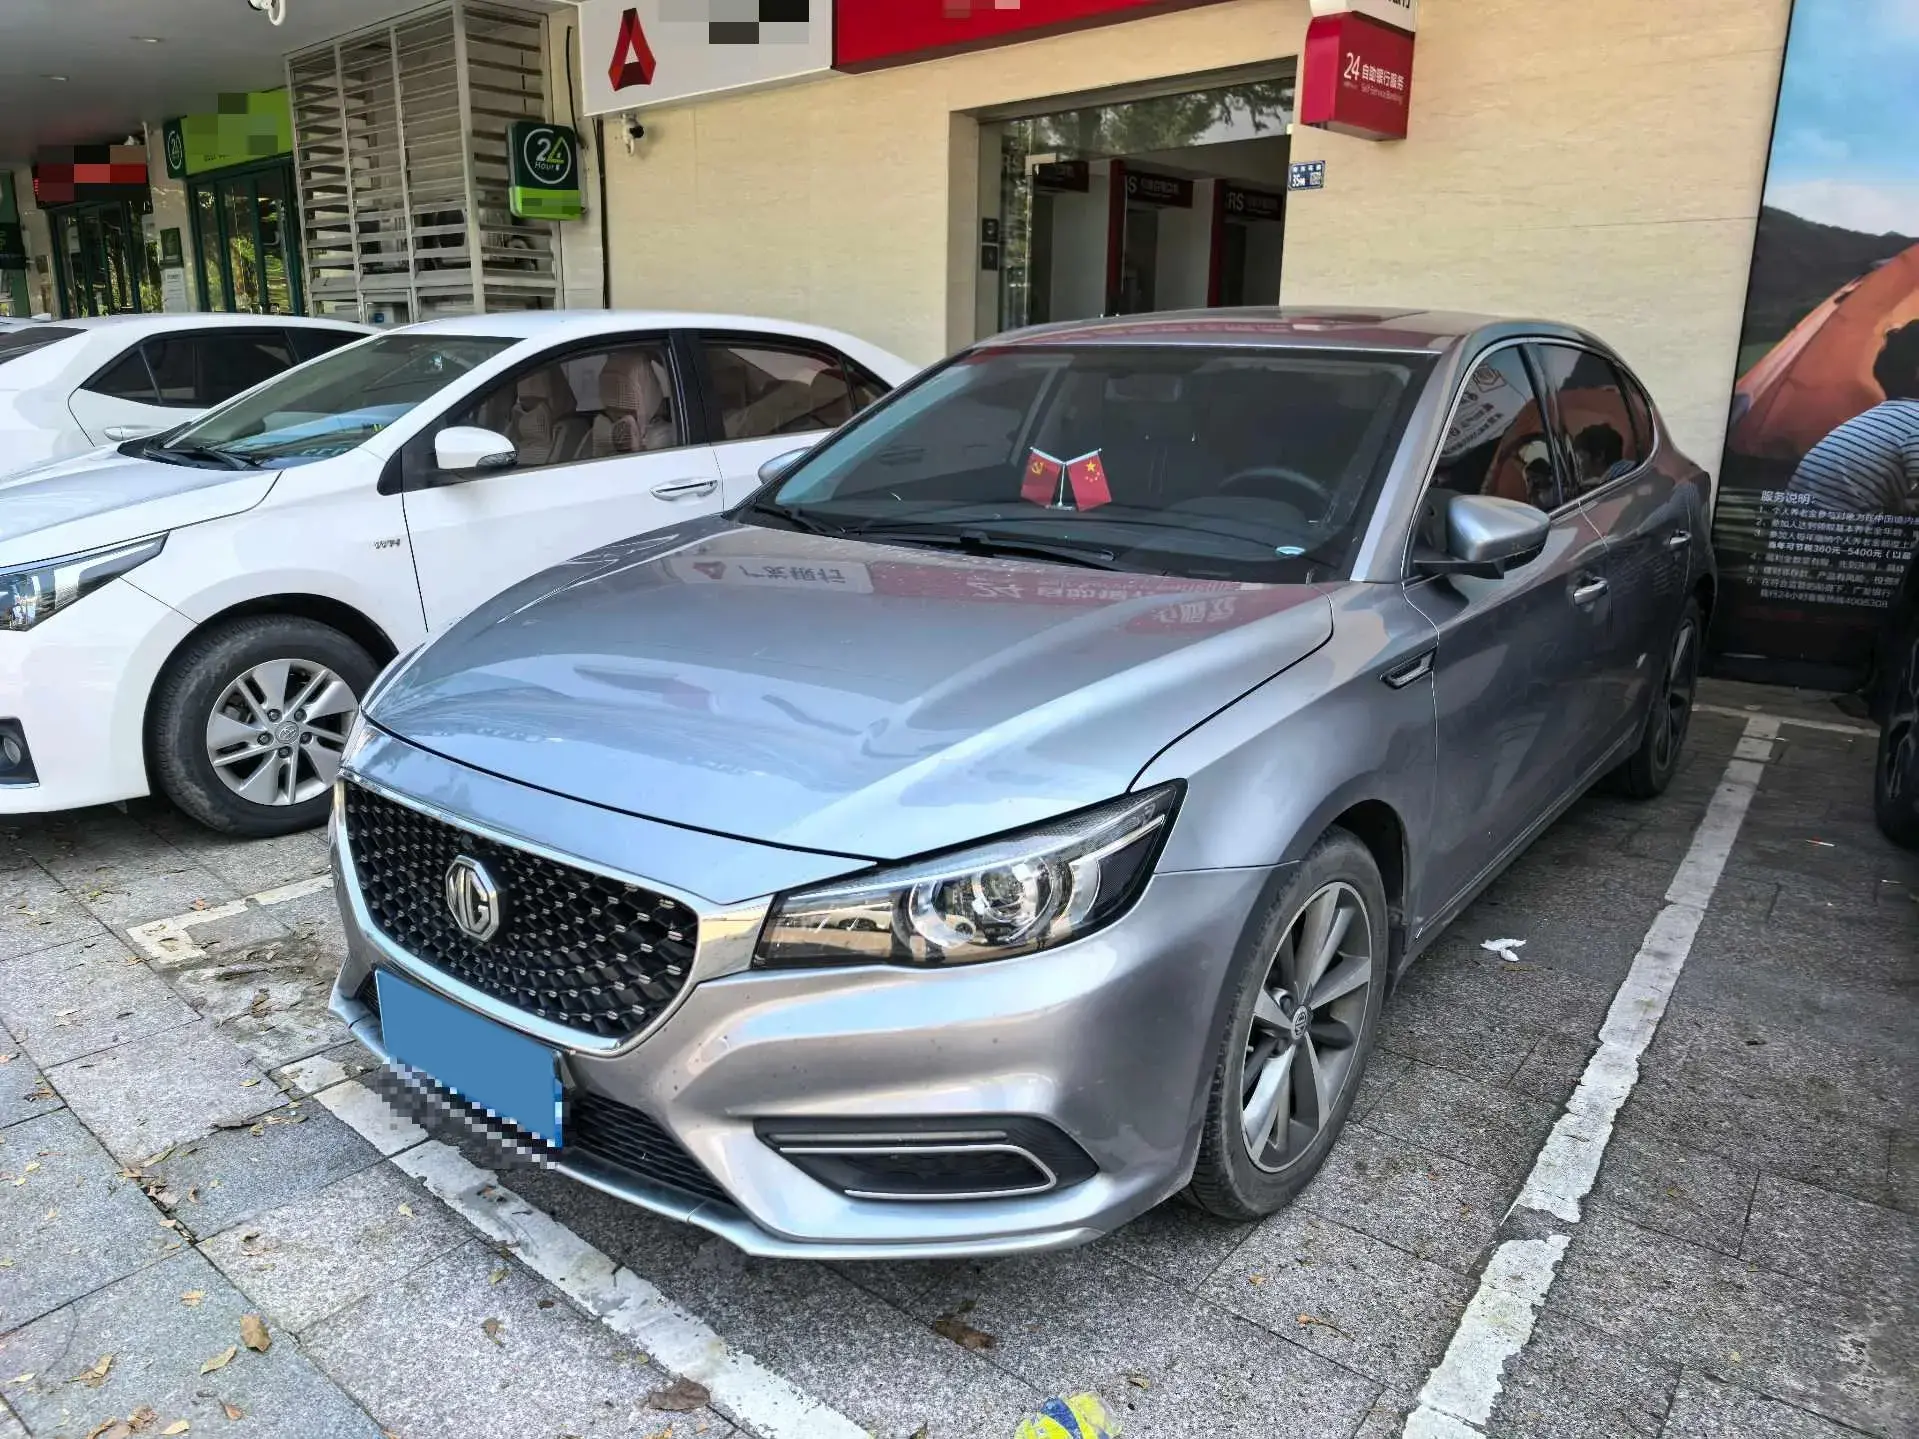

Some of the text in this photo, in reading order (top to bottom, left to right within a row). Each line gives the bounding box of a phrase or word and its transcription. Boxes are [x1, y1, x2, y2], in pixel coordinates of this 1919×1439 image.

[1344, 52, 1360, 80] 24
[1362, 63, 1405, 91] 自助银行服务
[536, 136, 565, 170] 24
